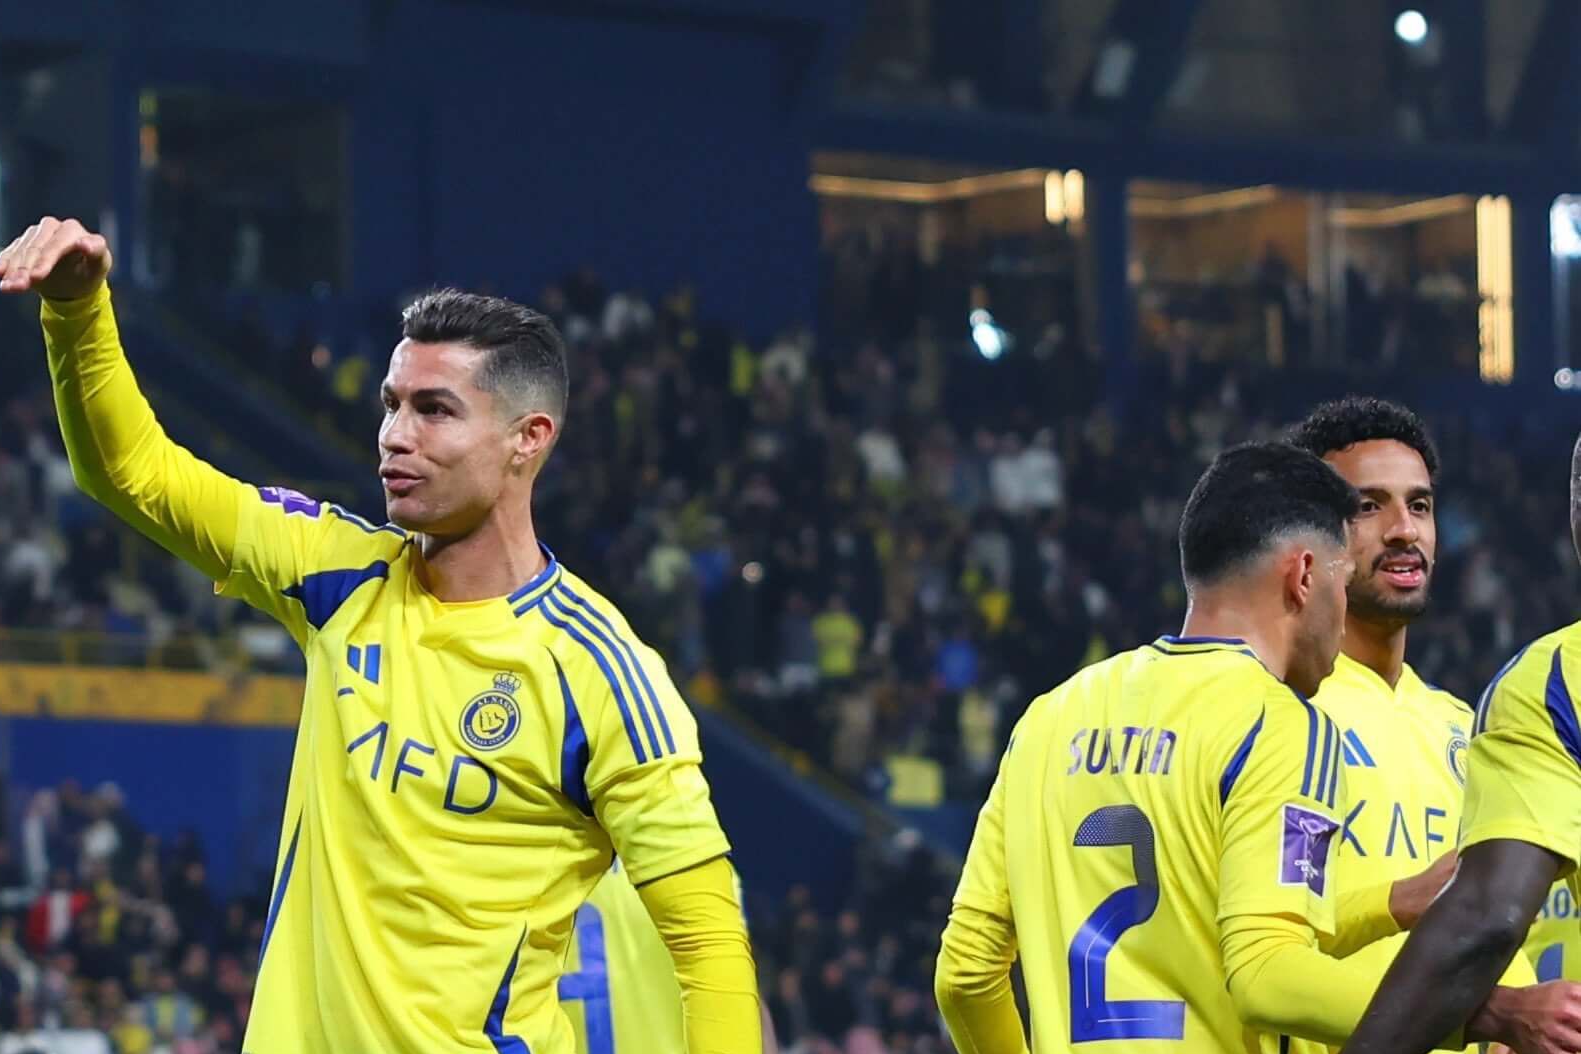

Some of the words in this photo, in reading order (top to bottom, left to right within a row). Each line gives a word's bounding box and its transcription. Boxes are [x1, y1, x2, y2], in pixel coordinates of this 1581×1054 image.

[338, 687, 499, 815] AFD
[1066, 726, 1177, 776] SULTAN
[1338, 800, 1462, 862] KAF
[1067, 803, 1186, 1044] 2
